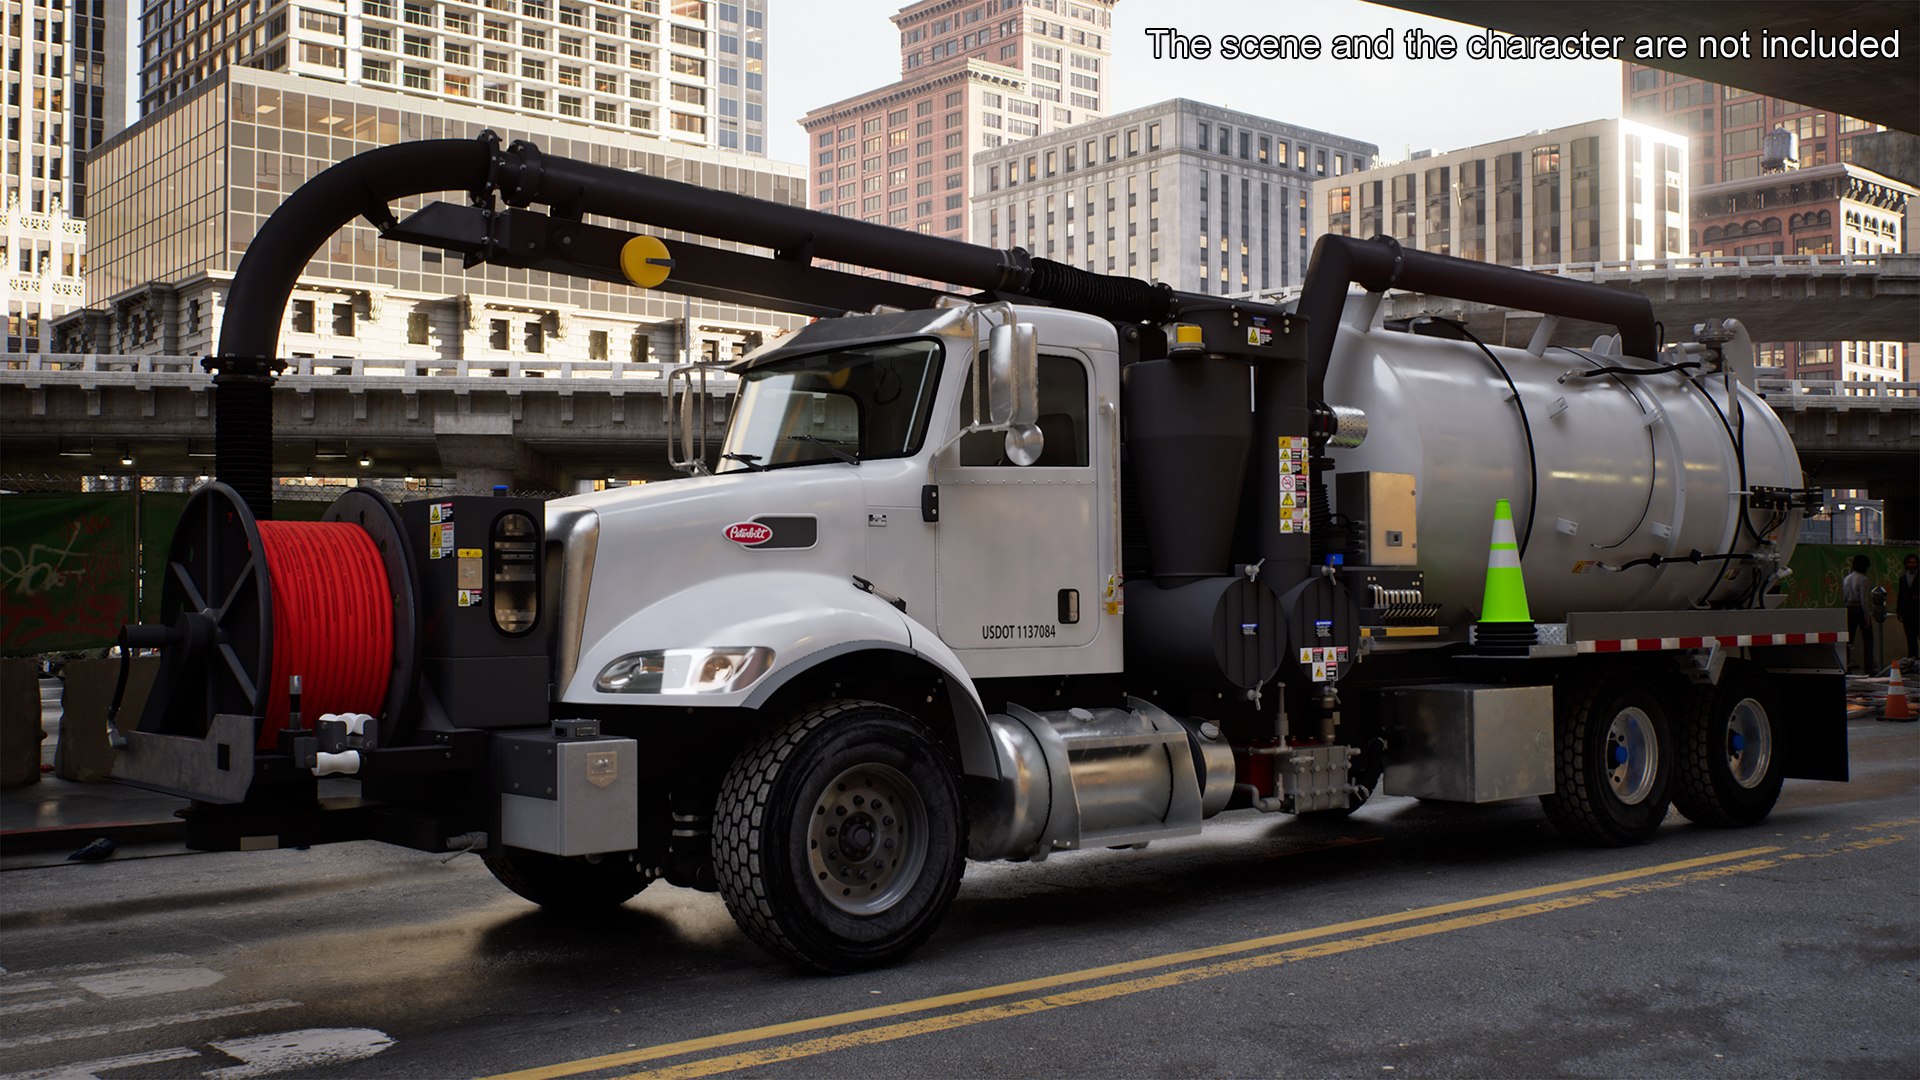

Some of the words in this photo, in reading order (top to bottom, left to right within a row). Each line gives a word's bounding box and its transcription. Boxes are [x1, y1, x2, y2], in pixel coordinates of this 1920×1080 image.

[730, 525, 768, 539] Peterbilt
[982, 625, 1015, 639] USDOT
[1017, 624, 1056, 638] 1137084
